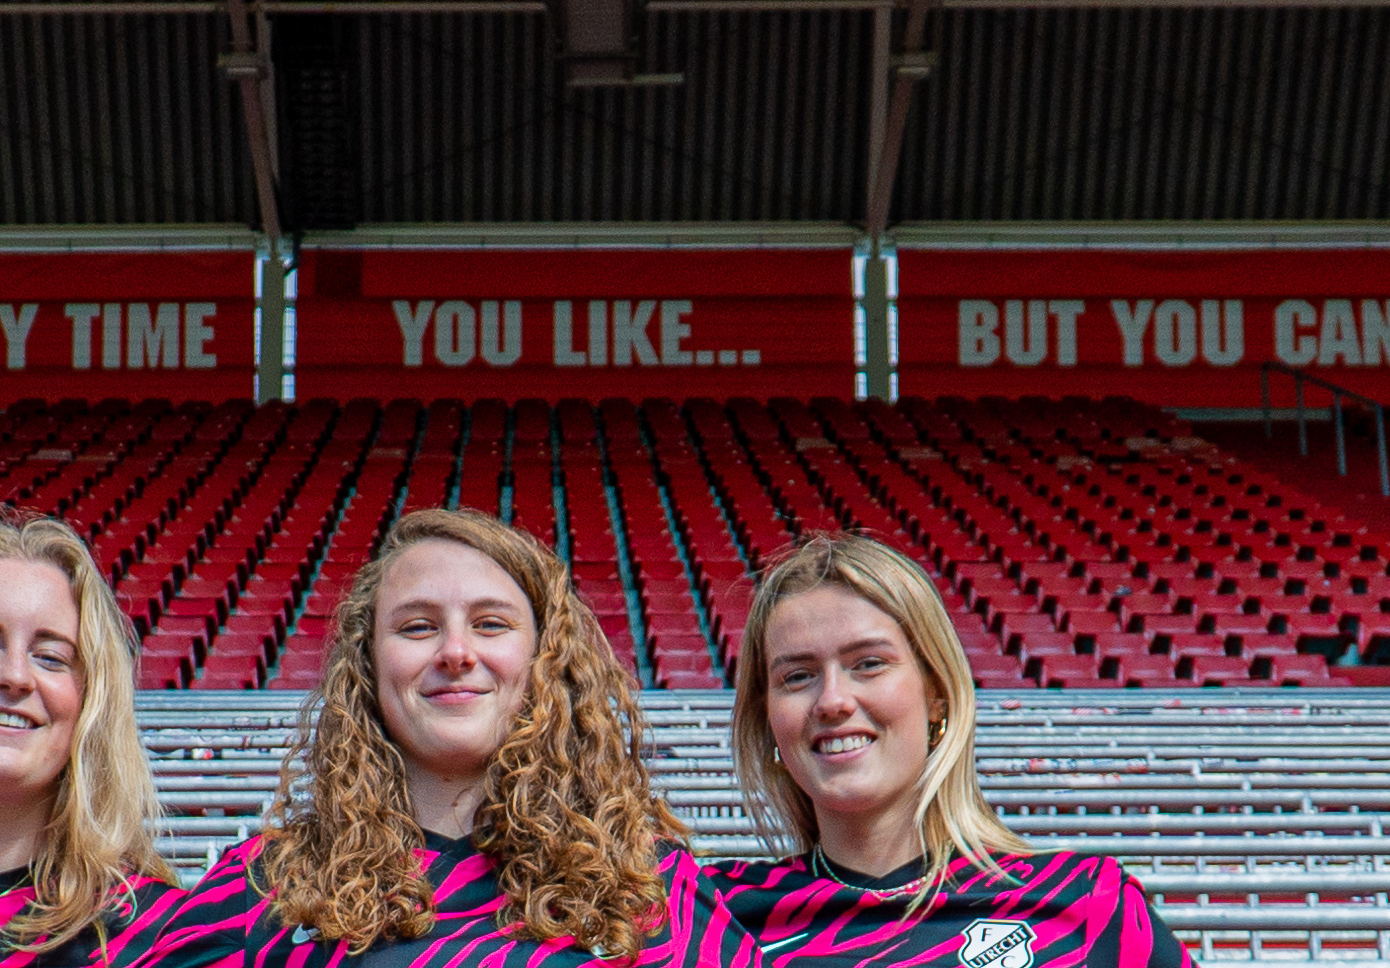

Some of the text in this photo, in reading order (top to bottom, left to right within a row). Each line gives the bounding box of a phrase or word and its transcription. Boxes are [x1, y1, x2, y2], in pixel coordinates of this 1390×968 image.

[65, 303, 217, 368] TIME
[394, 300, 761, 366] YOU LIKE...
[959, 300, 1085, 366] BUT
[1112, 300, 1244, 366] YOU
[969, 927, 1029, 968] UTRECHT
[980, 927, 993, 942] F
